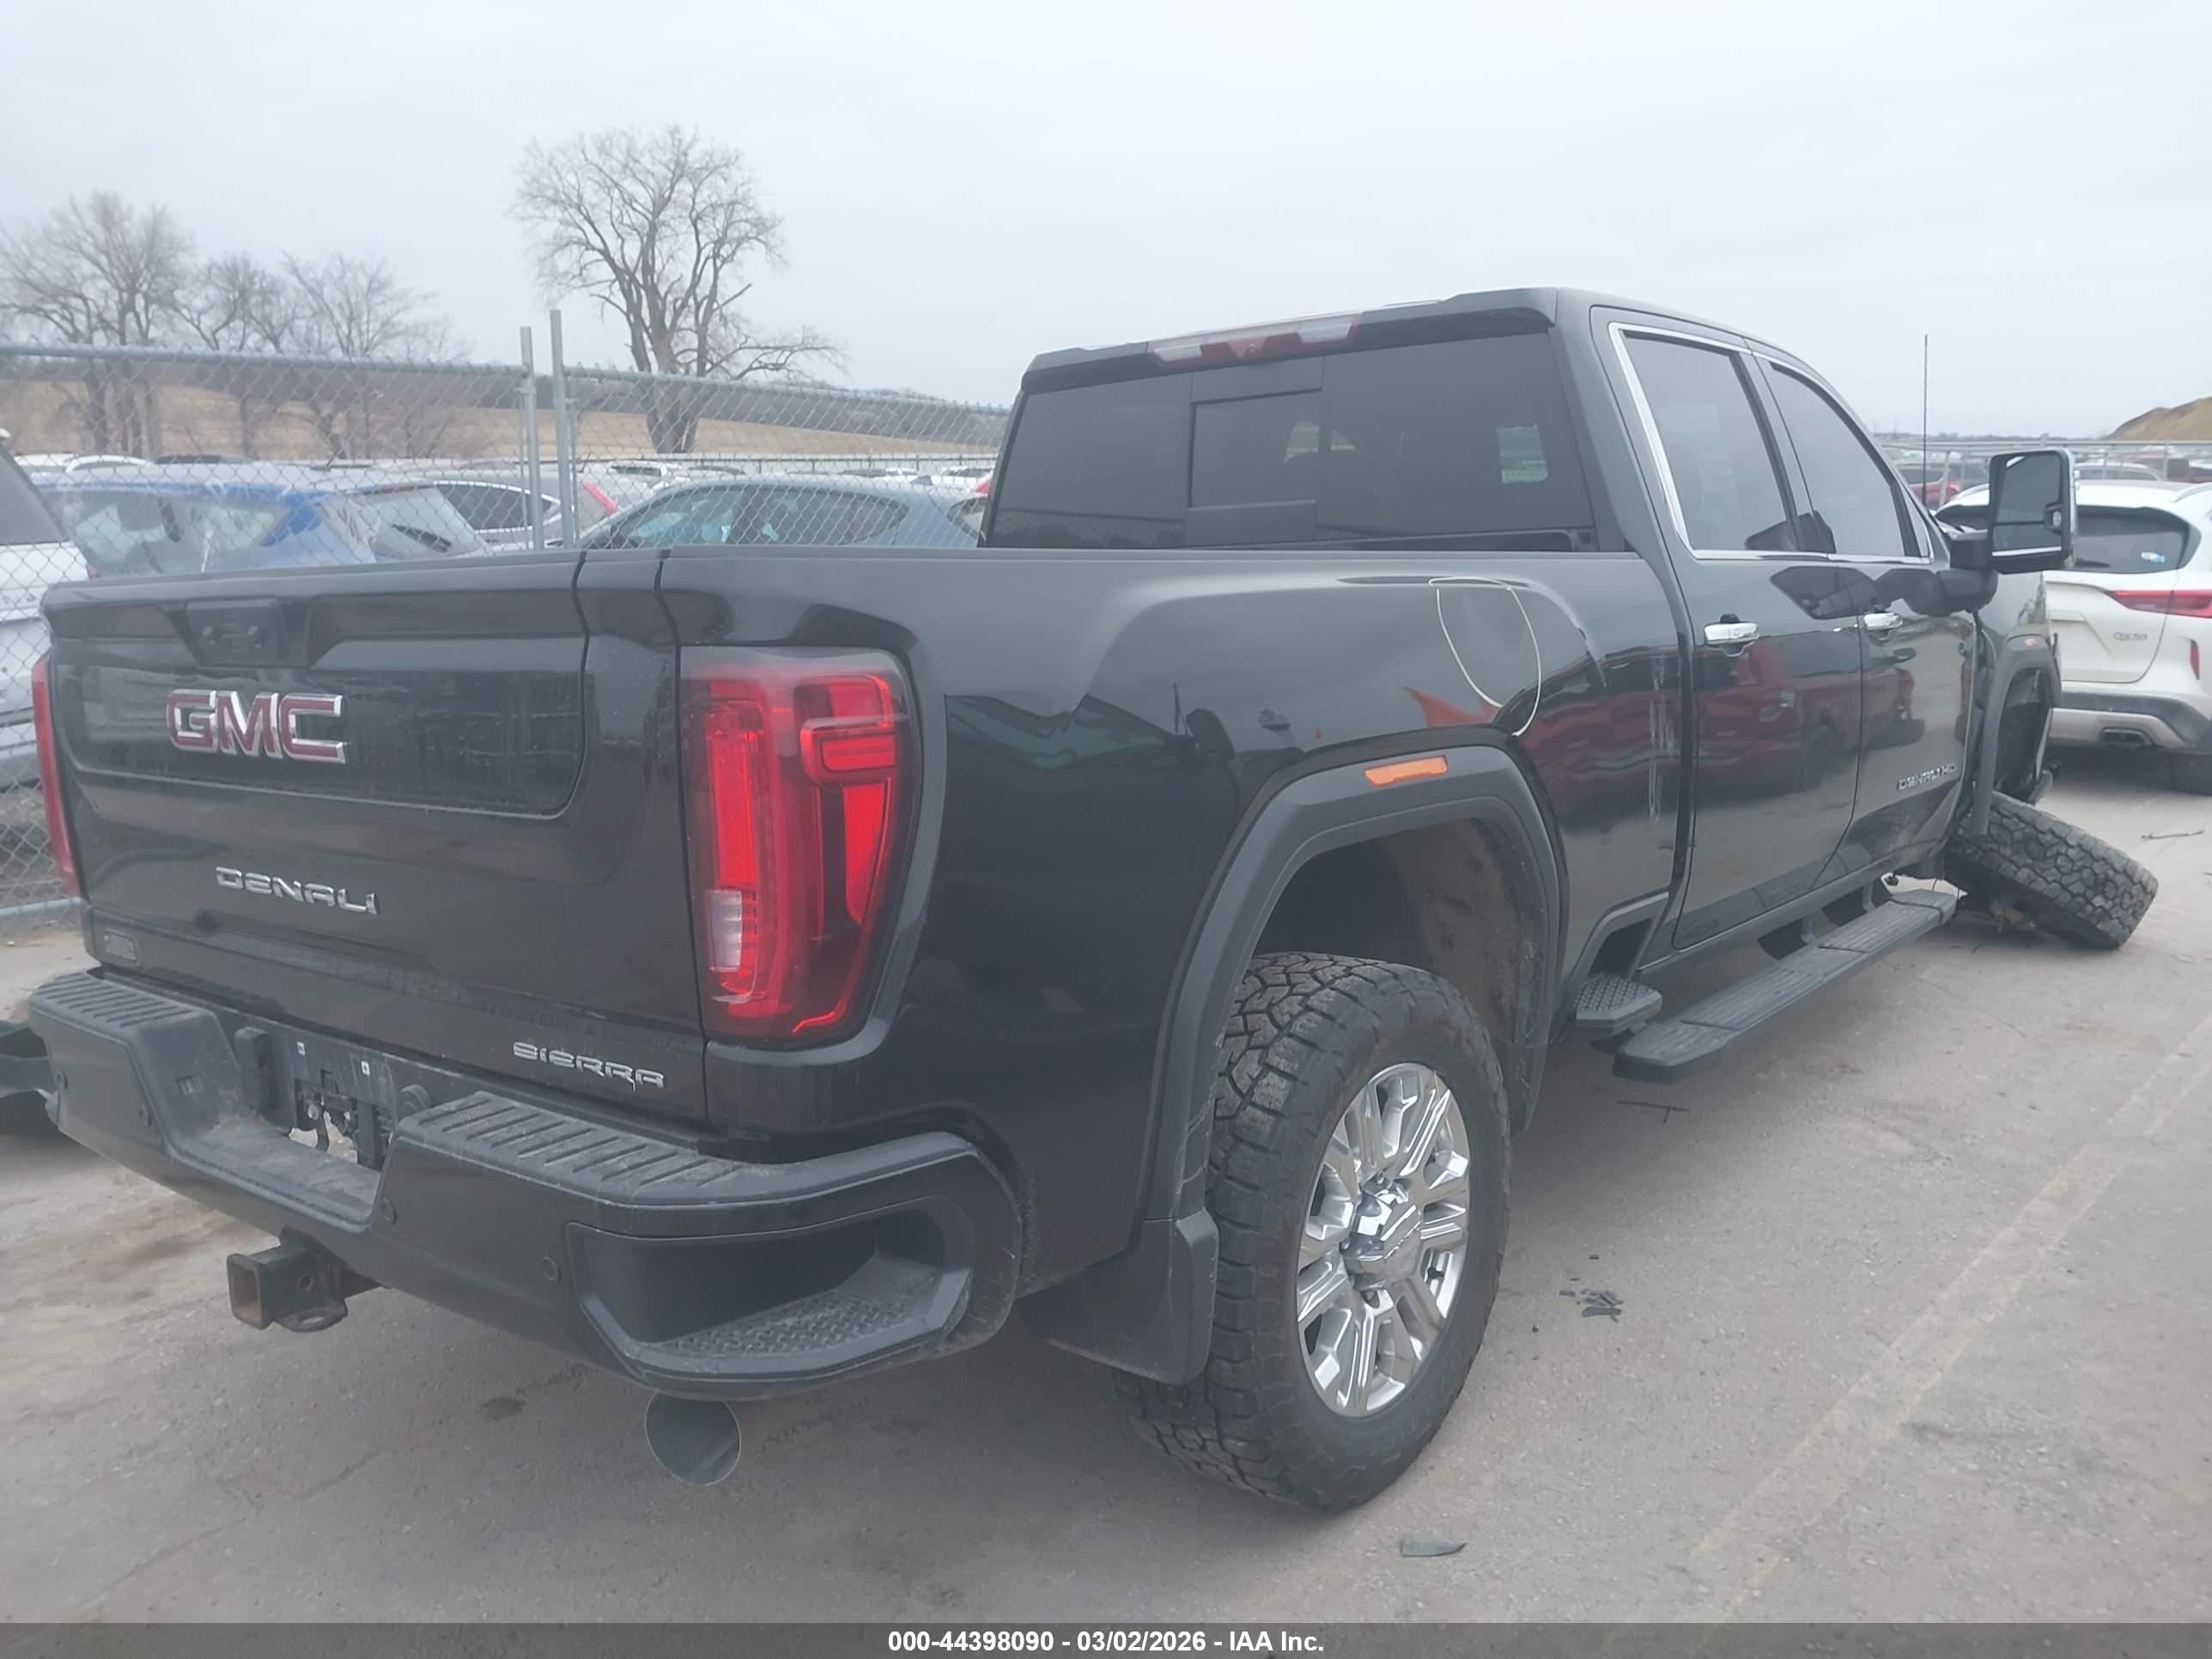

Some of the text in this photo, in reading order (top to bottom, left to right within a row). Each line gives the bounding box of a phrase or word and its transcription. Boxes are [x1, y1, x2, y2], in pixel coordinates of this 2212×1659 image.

[166, 689, 346, 763] GMC
[1897, 767, 1941, 790] DENALI
[216, 866, 378, 915] DENALI
[513, 1042, 664, 1092] SIERRA
